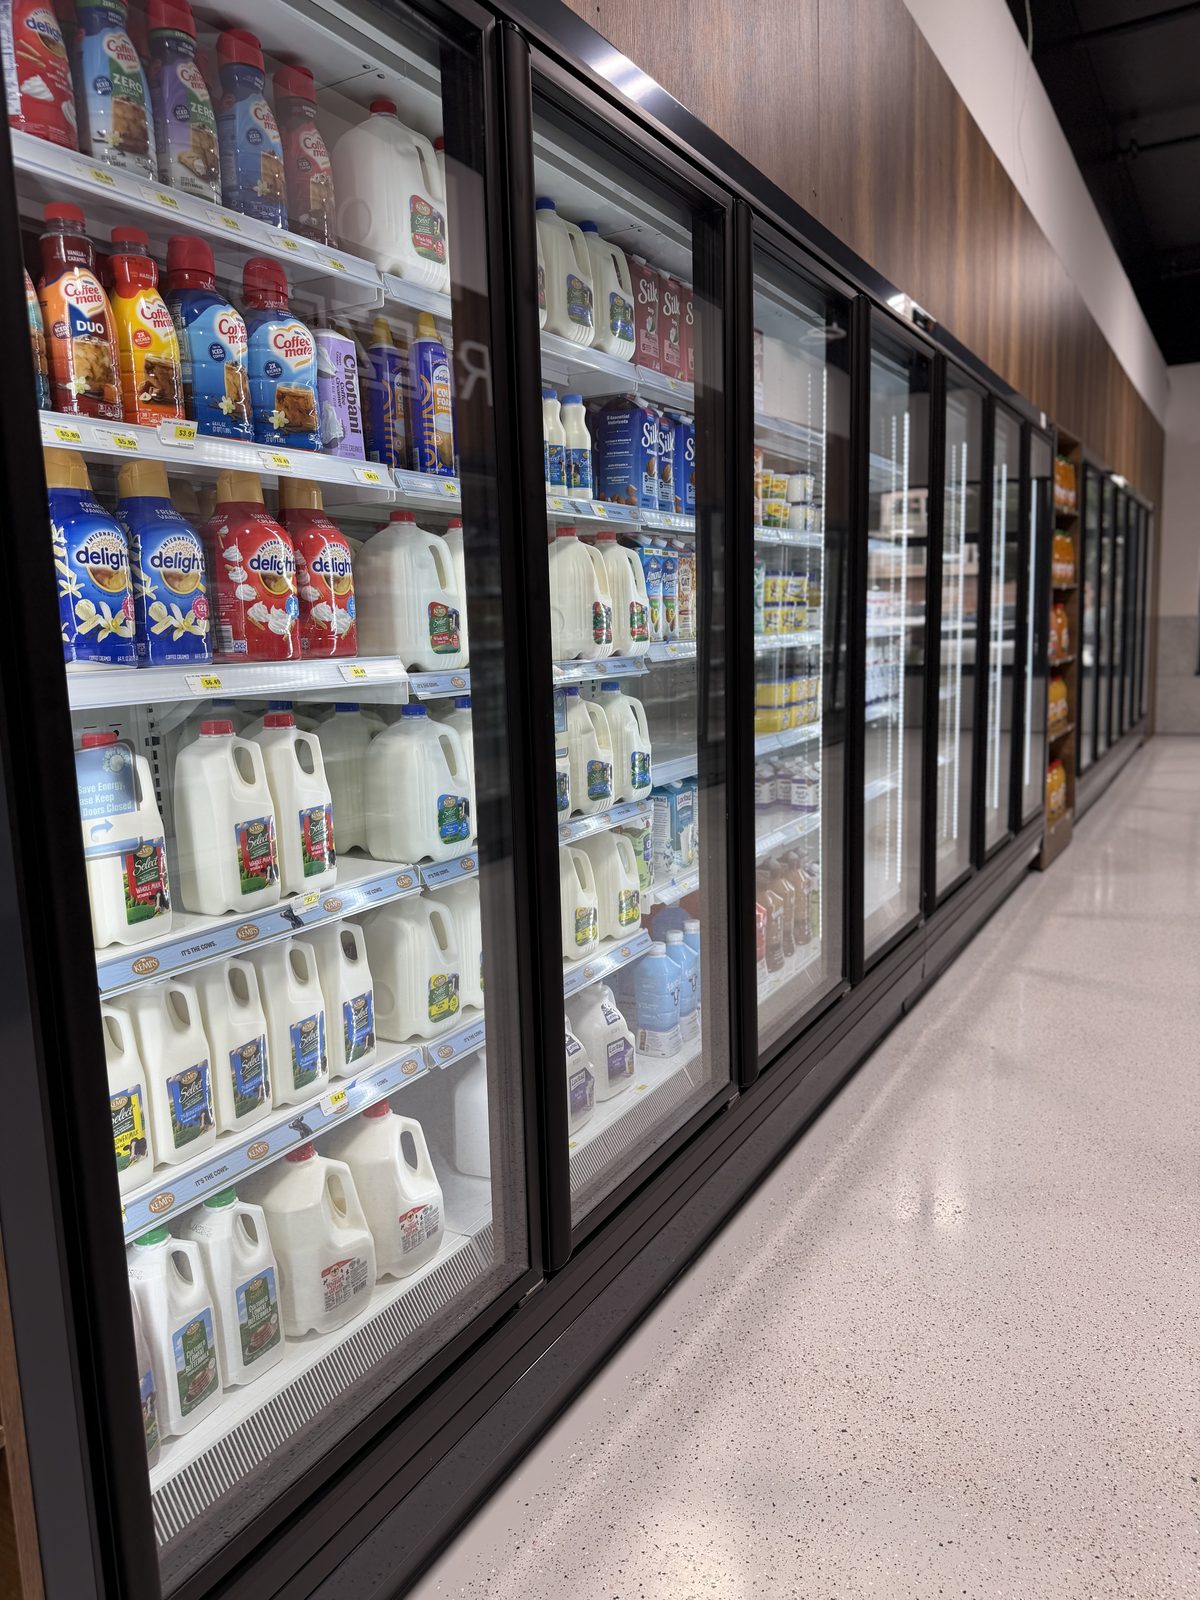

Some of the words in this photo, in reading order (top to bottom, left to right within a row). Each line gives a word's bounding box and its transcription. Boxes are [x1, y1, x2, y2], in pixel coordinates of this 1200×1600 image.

[112, 73, 143, 93] ZERO
[75, 294, 103, 305] mate
[638, 278, 659, 304] Silk
[663, 292, 680, 316] Silk
[76, 320, 104, 334] DUO
[273, 333, 311, 350] Coffee
[284, 347, 313, 358] mate
[335, 377, 343, 409] Creamer
[342, 354, 361, 435] Chobani
[60, 430, 80, 438] $5.89
[118, 438, 136, 446] $5.89
[641, 422, 659, 447] Silk
[658, 431, 675, 456] Silk
[644, 474, 649, 483] 5
[660, 481, 664, 489] 5
[688, 485, 693, 493] 5
[95, 793, 114, 805] Keep
[82, 806, 105, 817] Doors
[247, 833, 268, 851] Select
[133, 855, 159, 876] Select
[134, 959, 158, 974] KEMPS
[181, 948, 191, 957] IT'S
[191, 945, 201, 955] THE
[201, 941, 217, 951] COWS.
[238, 927, 258, 939] KEMPS
[241, 1054, 261, 1075] Select
[181, 1071, 198, 1084] KEMPS
[179, 1079, 203, 1103] Select
[150, 1195, 174, 1210] KEMPS
[195, 1178, 205, 1187] IT'S
[204, 1172, 214, 1182] THE
[213, 1166, 229, 1177] COWS.
[249, 1143, 269, 1158] KEMPS
[247, 1306, 273, 1327] BUTTERMILK
[185, 1352, 210, 1374] BUTTERMILK
